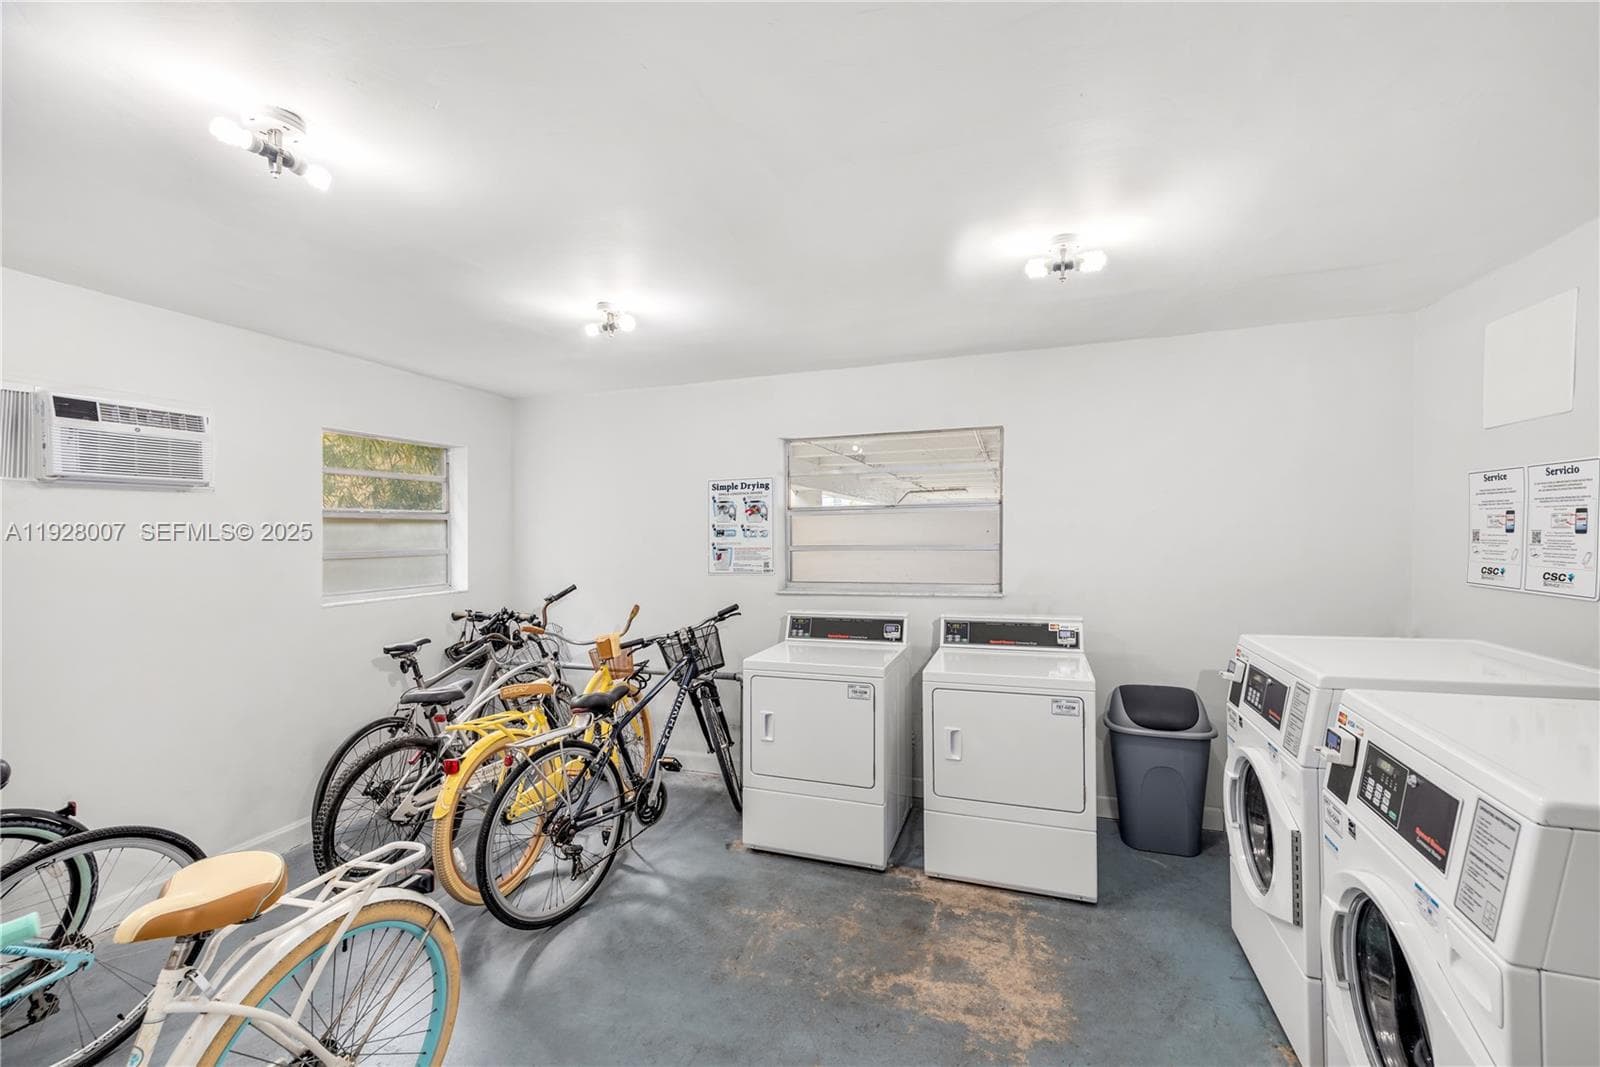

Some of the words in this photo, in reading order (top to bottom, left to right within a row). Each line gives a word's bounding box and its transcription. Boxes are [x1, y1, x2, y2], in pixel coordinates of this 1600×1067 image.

[1545, 465, 1580, 476] Servicio
[1483, 473, 1507, 482] Service
[712, 482, 739, 492] Simple
[740, 481, 770, 491] Drying
[1481, 566, 1500, 576] CSC
[1542, 571, 1567, 582] CSC
